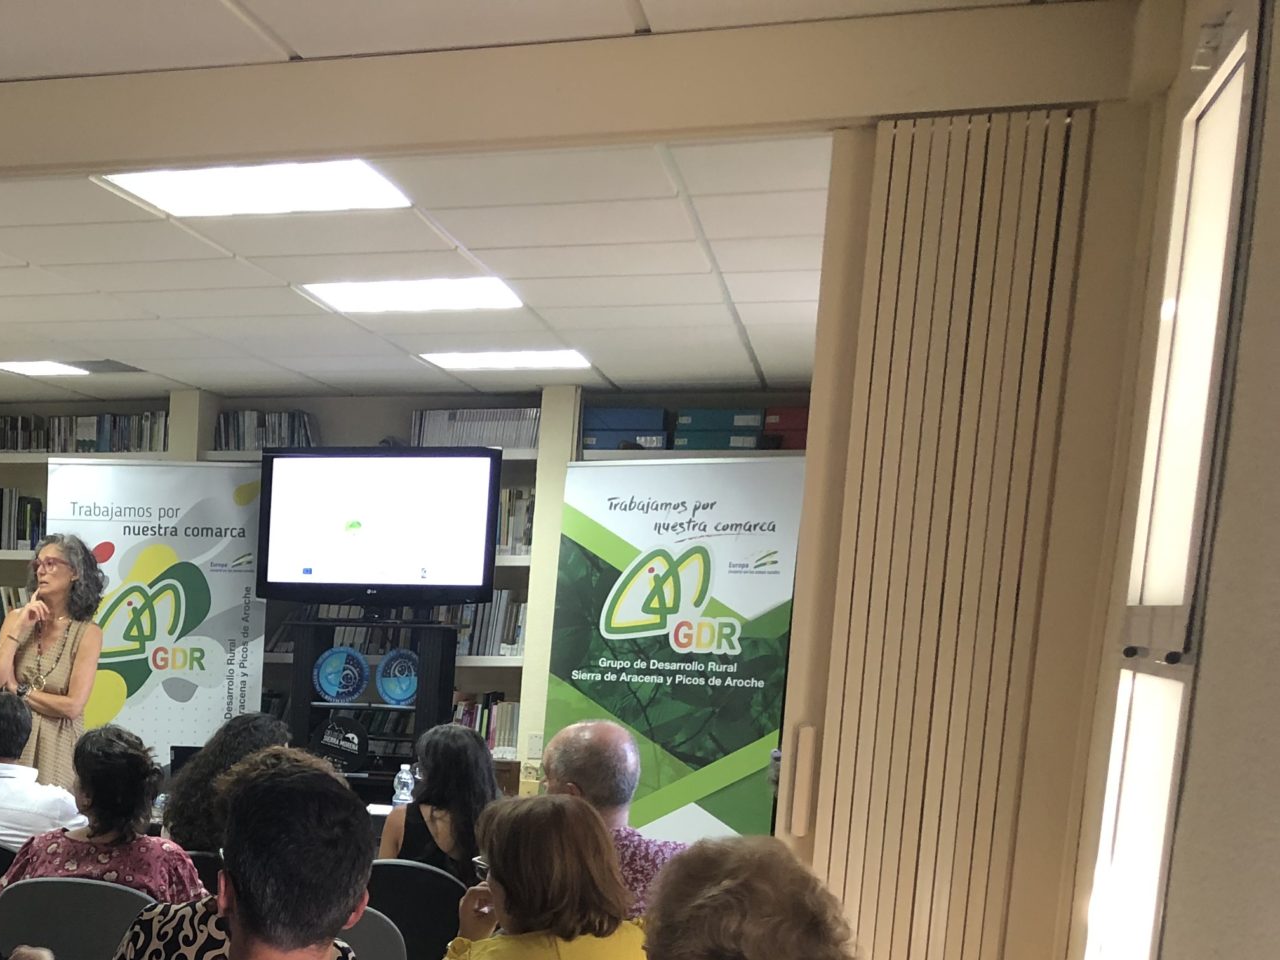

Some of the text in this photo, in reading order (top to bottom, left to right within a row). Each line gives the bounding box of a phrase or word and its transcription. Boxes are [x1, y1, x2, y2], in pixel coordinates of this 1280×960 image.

[70, 501, 181, 521] Trabajamos por
[607, 496, 717, 518] Trabajamos por
[123, 523, 246, 538] nuestra comarca
[654, 518, 777, 535] nuestra comarca
[242, 586, 252, 623] Aroche
[241, 625, 250, 638] de
[673, 620, 736, 650] GDR
[152, 646, 206, 671] GDR
[239, 641, 249, 669] Picos
[599, 657, 738, 673] Grupo de Desarrollo Rural
[224, 639, 236, 720] Desarrollo Rural
[571, 670, 765, 688] Sierra de Aracena y Picos de Aroche
[239, 680, 247, 714] racena
